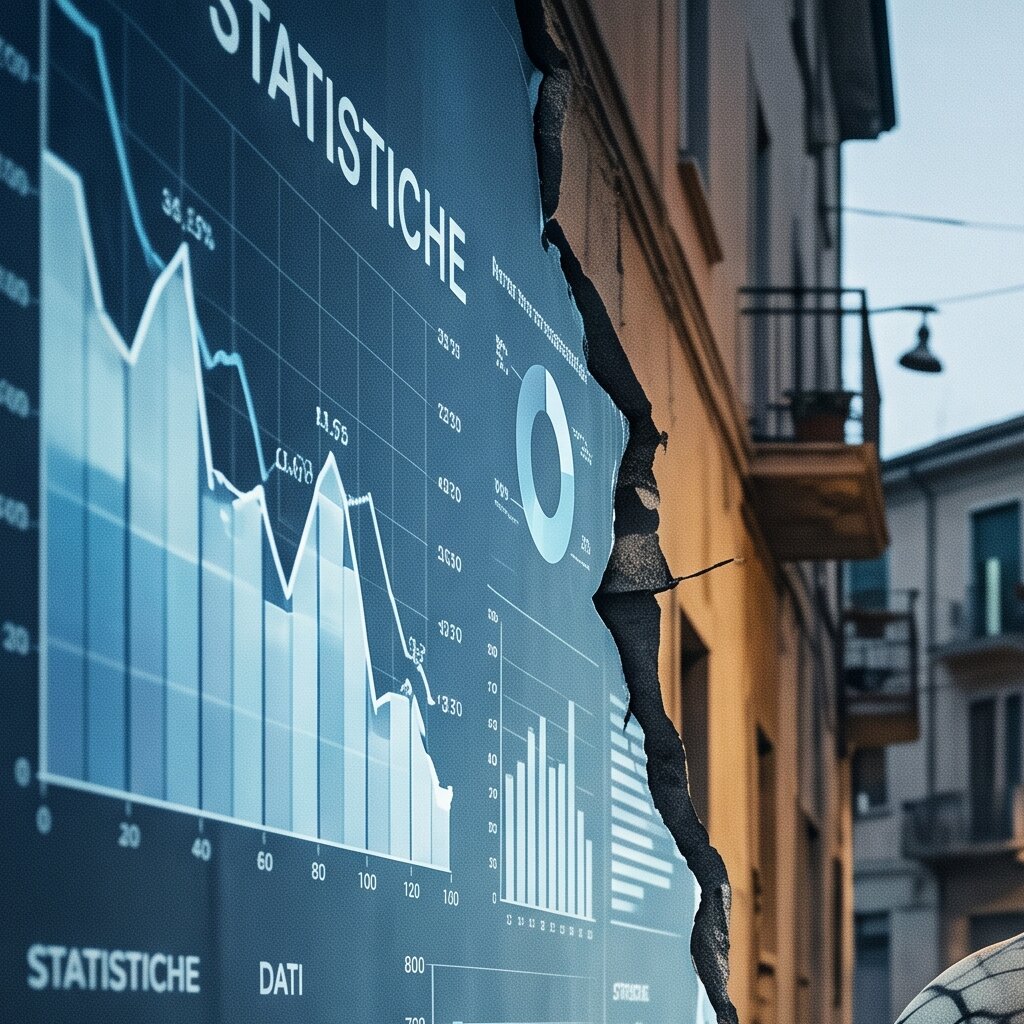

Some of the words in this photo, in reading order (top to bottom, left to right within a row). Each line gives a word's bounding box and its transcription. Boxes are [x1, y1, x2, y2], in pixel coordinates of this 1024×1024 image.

[209, 0, 467, 305] STATISTICHE
[117, 822, 142, 848] 20
[191, 838, 212, 861] 40
[256, 851, 274, 872] 60
[311, 862, 326, 881] 80
[358, 871, 378, 891] 100
[403, 881, 421, 899] 120
[27, 944, 201, 994] STATISTICHE
[259, 960, 303, 996] DATI
[404, 955, 426, 975] 800
